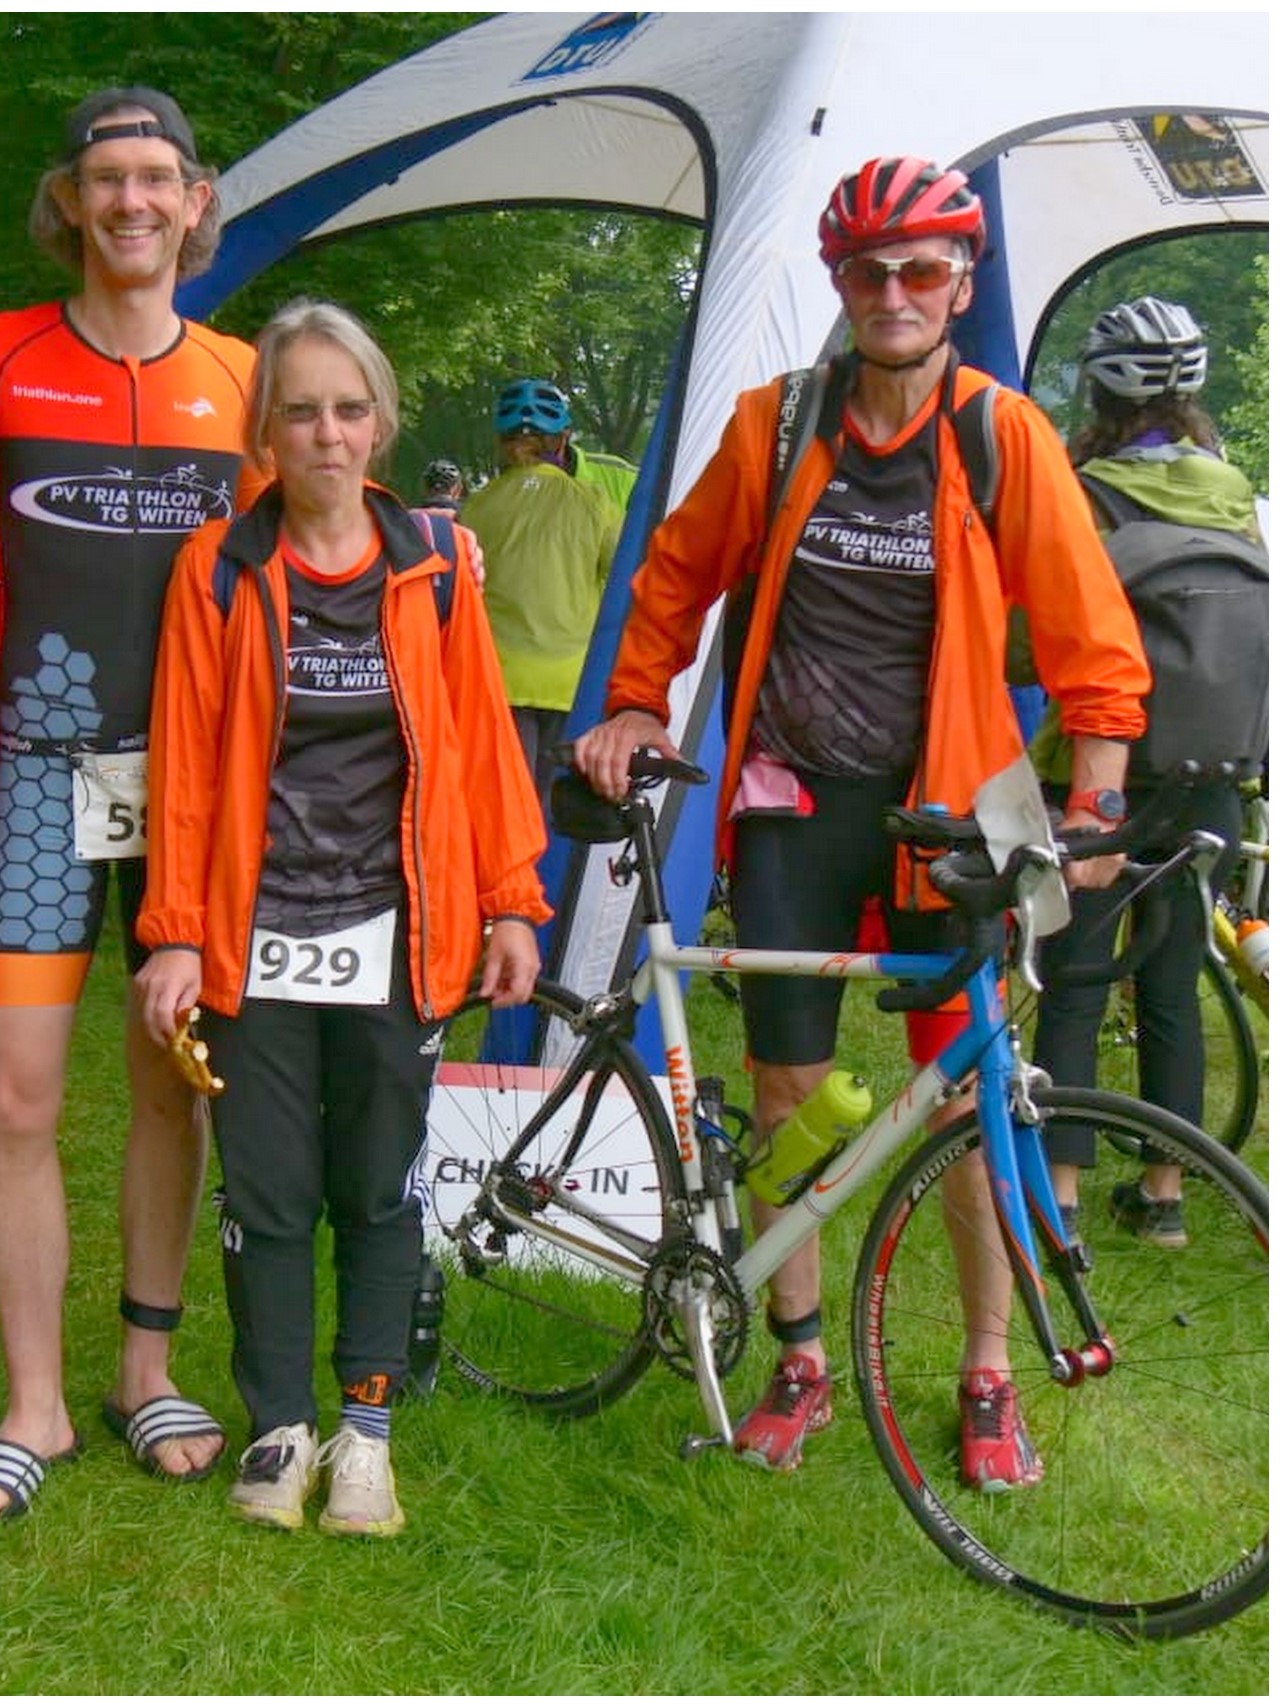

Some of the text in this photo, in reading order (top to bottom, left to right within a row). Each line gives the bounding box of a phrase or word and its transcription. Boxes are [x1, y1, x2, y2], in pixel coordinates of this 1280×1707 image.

[12, 384, 103, 406] triathlon.one
[50, 485, 202, 508] PV TRIATHLON
[101, 506, 207, 526] TG WITTEN
[804, 525, 931, 553] PV TRIATHLON
[841, 545, 865, 560] TG
[288, 656, 300, 671] V
[314, 672, 388, 688] TG WITTE
[258, 938, 361, 988] 929
[590, 1167, 629, 1196] IN
